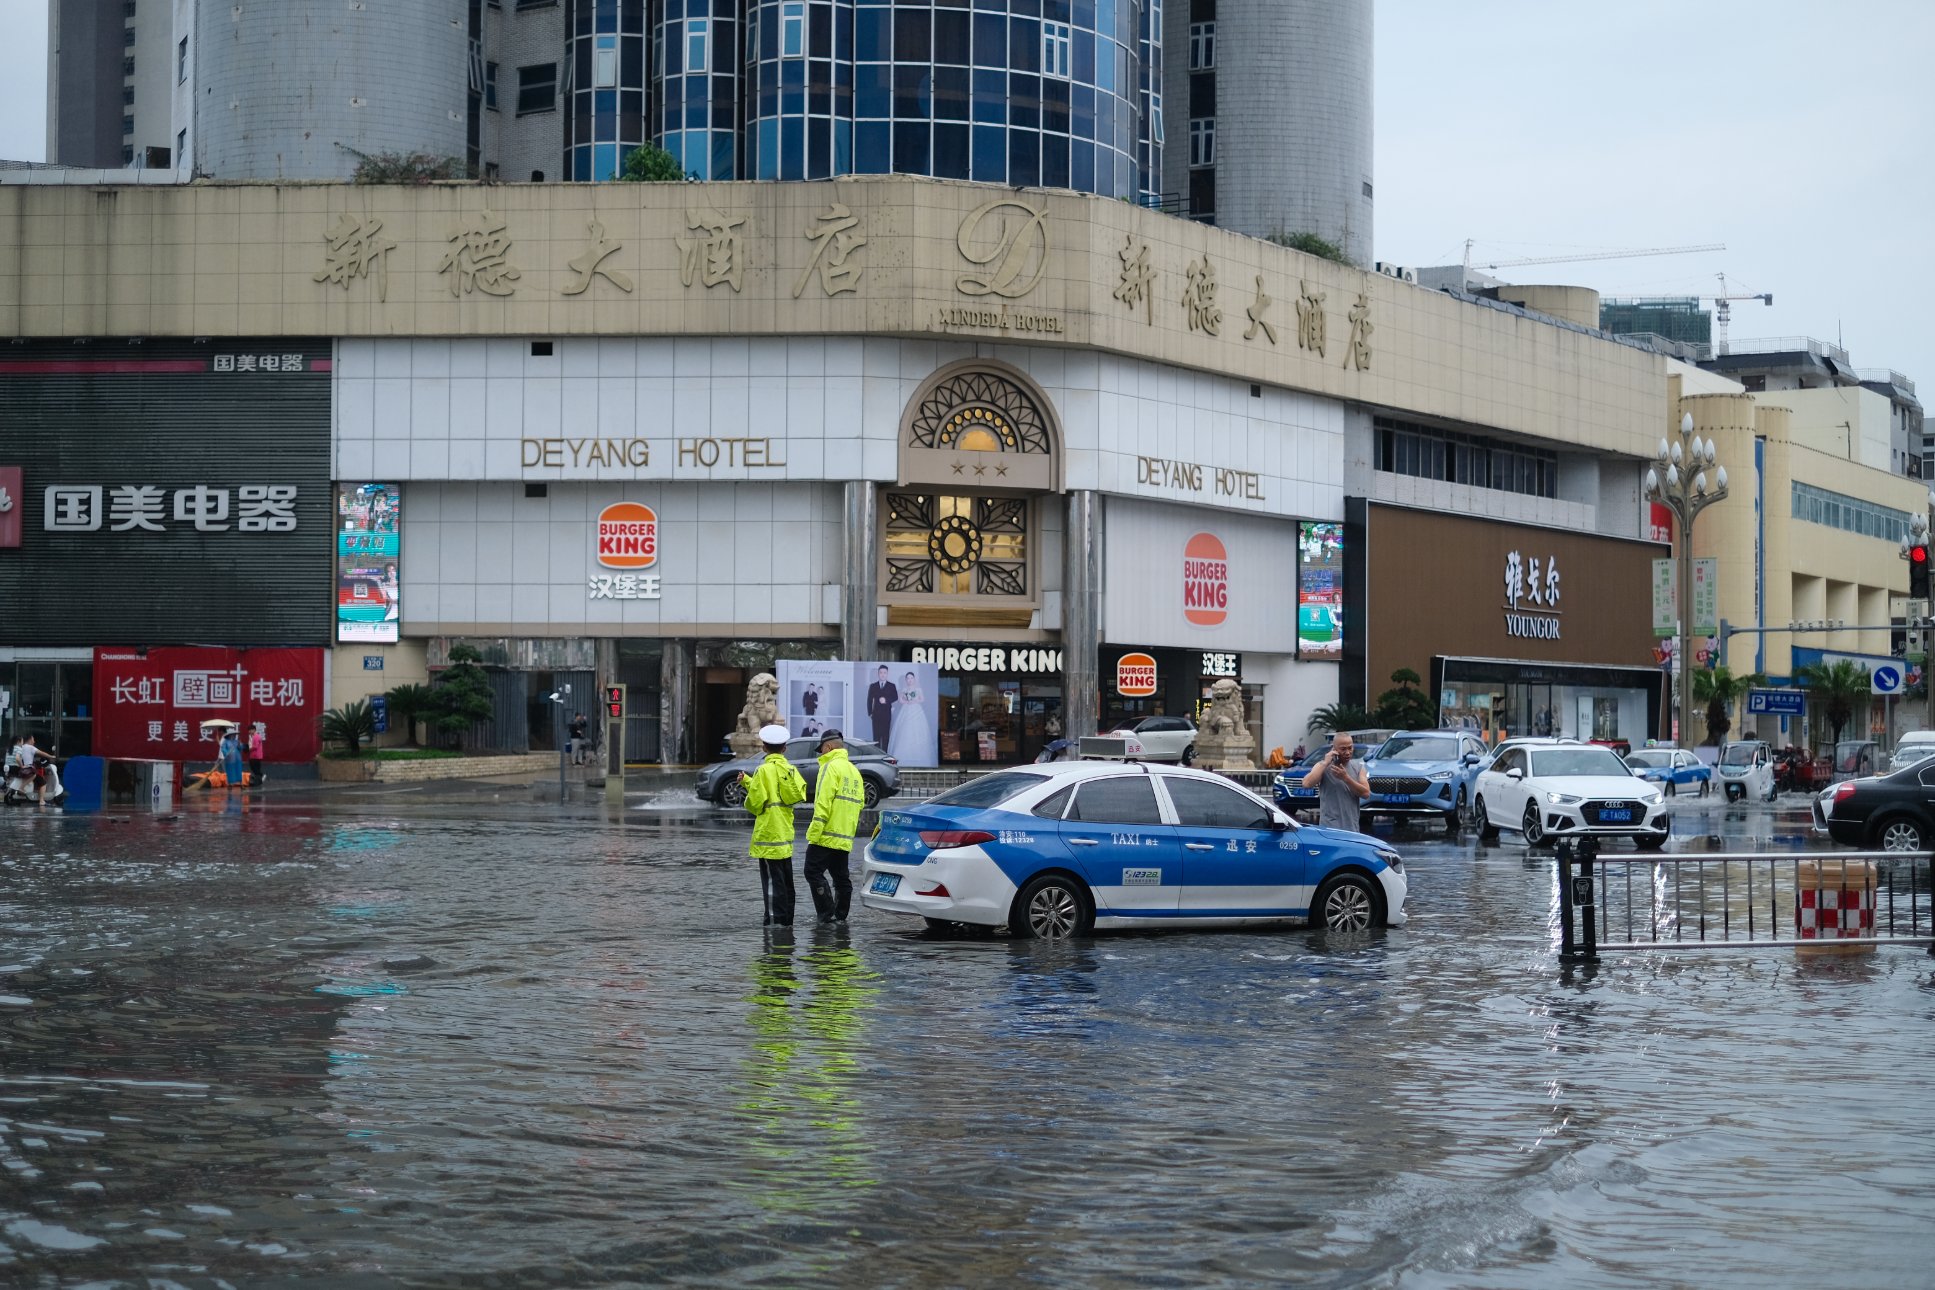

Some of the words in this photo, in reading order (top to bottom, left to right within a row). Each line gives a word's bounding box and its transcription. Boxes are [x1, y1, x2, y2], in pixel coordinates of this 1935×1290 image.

[313, 203, 868, 303] 新德大酒店
[1113, 235, 1376, 372] 新德大酒店
[939, 308, 1009, 330] XINDEDA
[1016, 314, 1064, 334] HOTEL
[213, 354, 303, 372] 国美电器
[521, 438, 649, 468] DEYANG
[678, 438, 787, 468] HOTEL
[1137, 455, 1202, 491] DEYANG
[1214, 467, 1265, 500] HOTEL
[44, 485, 297, 532] 国美电器
[599, 523, 656, 536] BURGER
[599, 537, 656, 555] KING
[1184, 560, 1228, 582] BURGER
[589, 574, 661, 600] 汉堡王
[1184, 579, 1228, 609] KING
[1505, 614, 1561, 640] YOUNGOR
[911, 647, 1007, 672] BURGER
[1010, 648, 1063, 673] KIN
[1119, 667, 1155, 675] BURGER
[1202, 652, 1237, 677] 汉堡王
[111, 676, 165, 704] 长虹
[251, 678, 304, 706] 电视
[1119, 676, 1155, 687] KING
[1111, 832, 1140, 846] TAXI
[1226, 838, 1258, 853] 迅安
[1279, 841, 1299, 851] 0259
